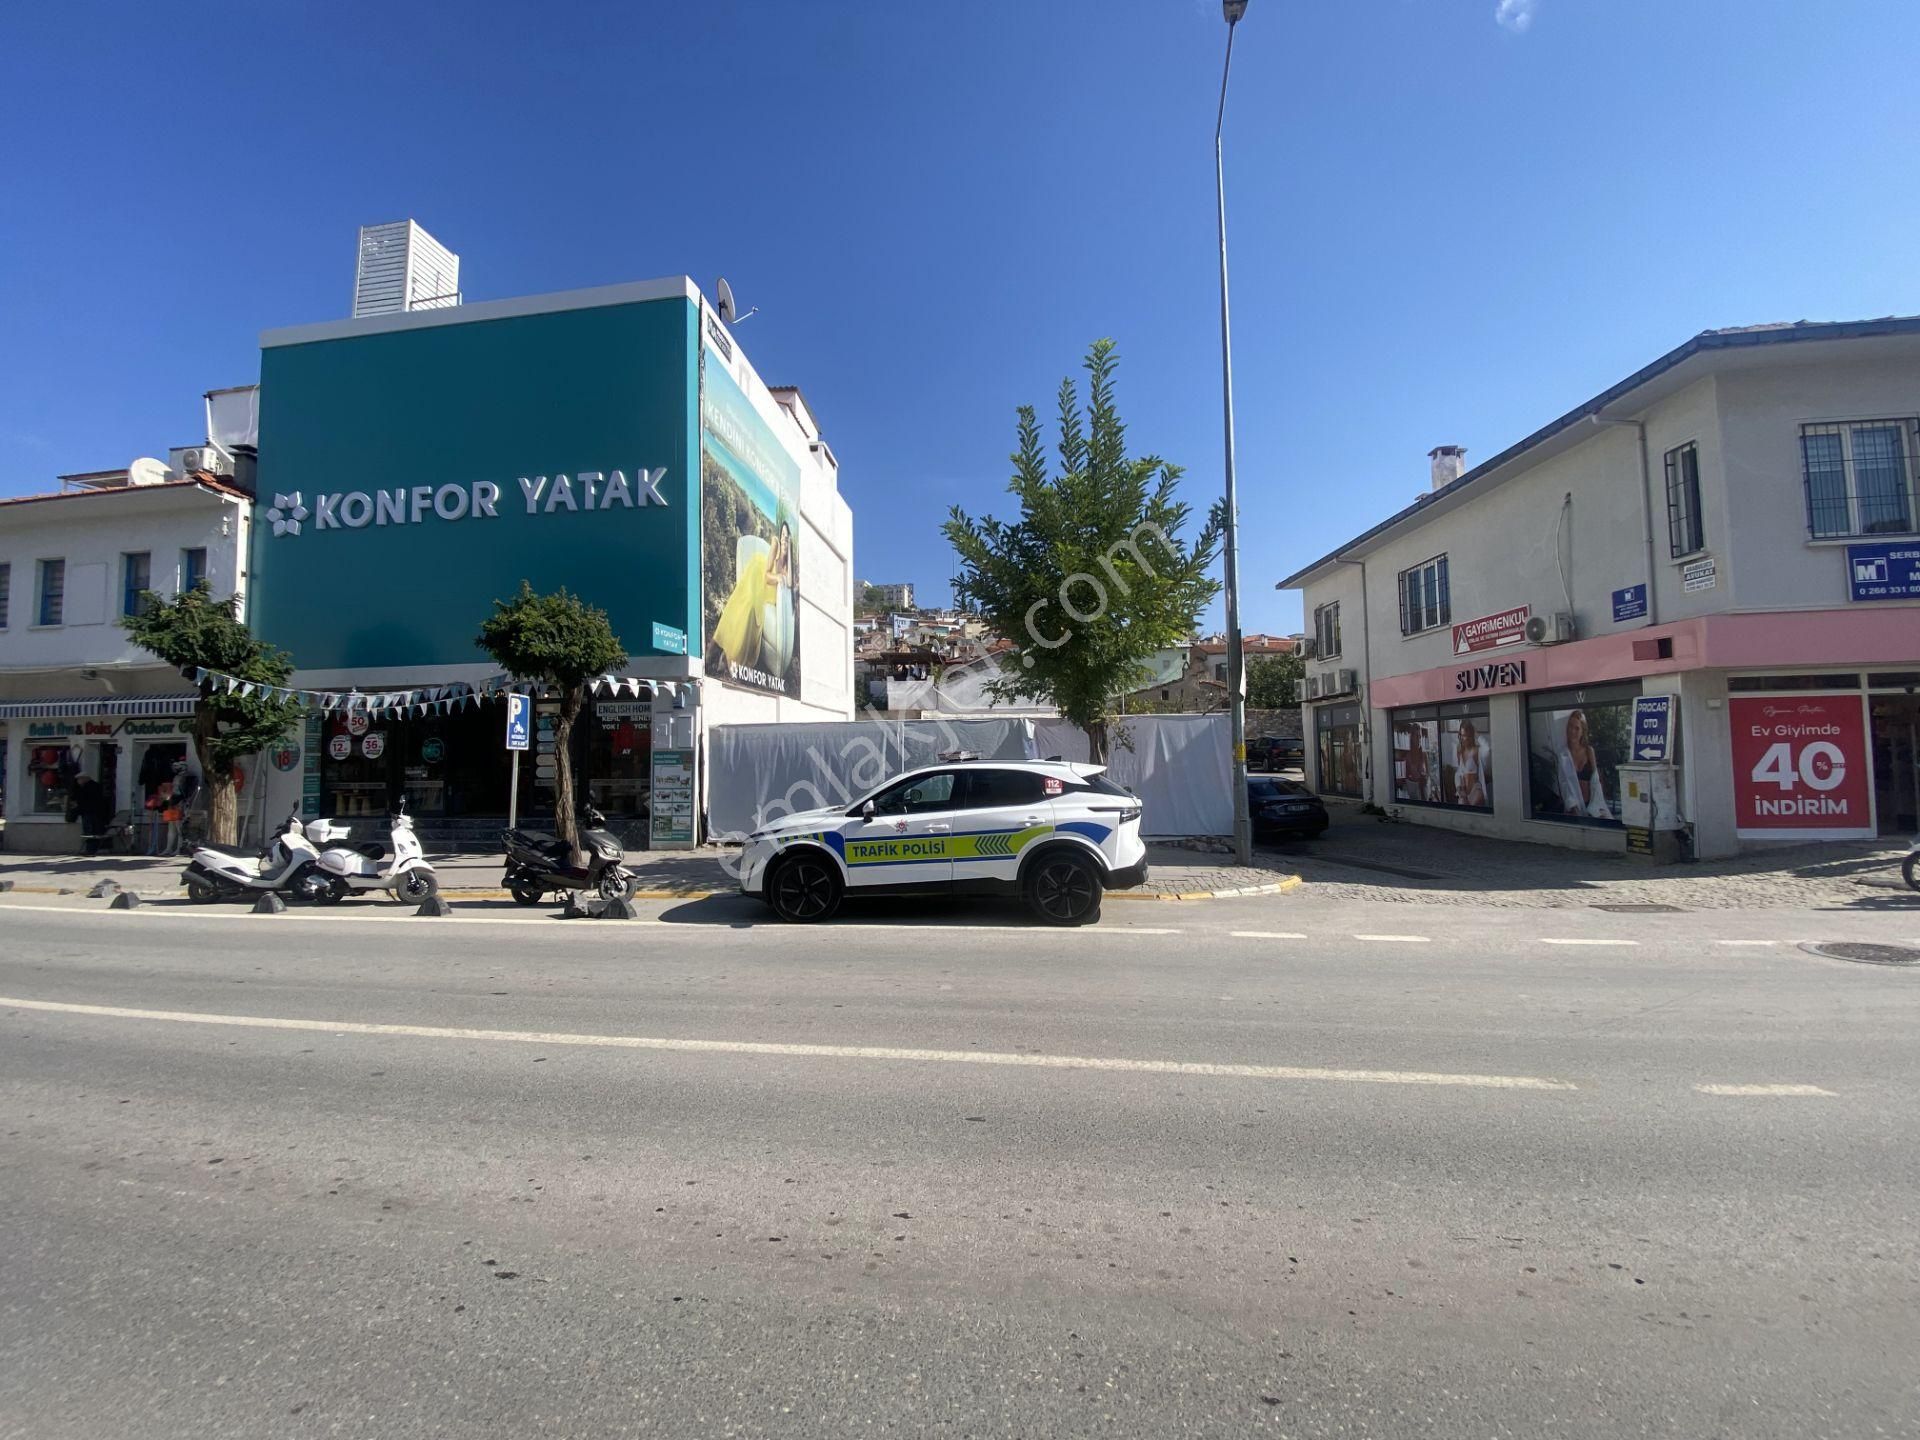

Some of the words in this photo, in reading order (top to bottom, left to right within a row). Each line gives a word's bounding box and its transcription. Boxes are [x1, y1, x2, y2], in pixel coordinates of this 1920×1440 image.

[315, 481, 500, 530] KONFOR
[518, 467, 669, 514] YATAK
[739, 665, 766, 686] KONFOR
[767, 674, 785, 692] YATAK
[1456, 661, 1526, 692] SUWEN
[510, 698, 522, 723] P
[599, 704, 631, 714] ENGLISH
[633, 704, 651, 713] HOM
[1638, 702, 1667, 712] PROCAR
[125, 719, 175, 735] Outdoor
[351, 717, 364, 726] 50
[1643, 718, 1658, 728] OTO
[1751, 725, 1771, 737] Ev
[1774, 724, 1841, 738] Giyimde
[332, 743, 344, 753] 12
[365, 740, 378, 750] 36
[1751, 741, 1846, 791] 40
[1047, 780, 1060, 788] 112
[1754, 794, 1848, 816] İNDİRİM
[852, 842, 899, 858] TRAFİK
[902, 839, 946, 856] POLİSİ
